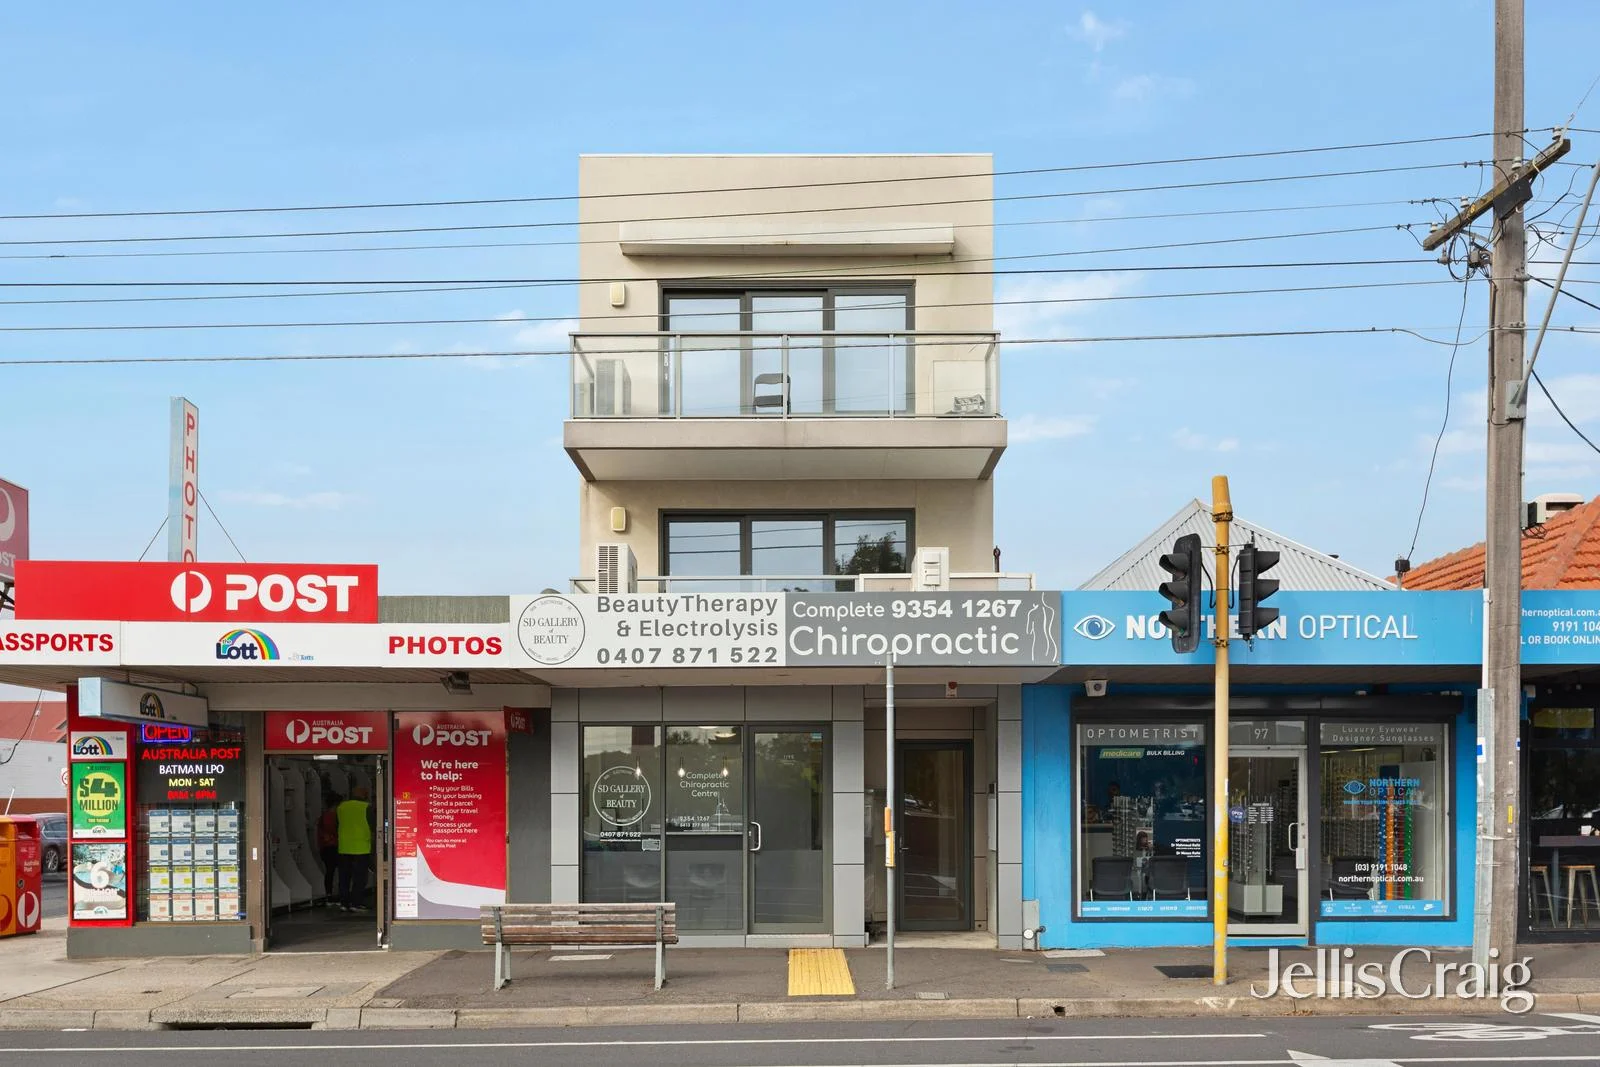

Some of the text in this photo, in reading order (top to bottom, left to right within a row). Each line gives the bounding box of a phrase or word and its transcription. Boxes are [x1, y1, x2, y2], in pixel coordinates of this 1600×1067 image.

[225, 573, 359, 613] POST
[792, 599, 1022, 621] Complete 9354 1267
[523, 617, 578, 627] SD GALLERY
[1299, 614, 1418, 639] OPTICAL
[1552, 621, 1578, 632] 9191
[616, 619, 778, 640] & Electrolysis
[0, 633, 113, 652] SSPORTS
[534, 634, 569, 644] BEAUTY
[789, 625, 1019, 663] Chiropractic
[1528, 635, 1541, 644] OR
[1544, 635, 1570, 644] BOOK
[216, 642, 258, 660] Lott
[388, 635, 502, 656] PHOTOS
[597, 647, 777, 664] 0407 871 522
[144, 725, 189, 739] OPEN
[312, 726, 373, 744] POST
[1087, 728, 1197, 738] OPTOMETRIST
[1254, 728, 1268, 739] 97
[1342, 725, 1419, 734] Luxury Eyewear
[436, 730, 492, 746] POST
[1332, 734, 1434, 743] Designer Sunglasses
[73, 744, 100, 755] Lott
[142, 748, 241, 760] AUSTRALIA POST
[159, 764, 224, 774] BATMAN LPO
[421, 760, 479, 769] We're here
[421, 770, 463, 782] to help:
[79, 778, 118, 797] $4
[168, 778, 192, 787] MON
[199, 778, 215, 786] SAT
[680, 780, 729, 789] Chiropractic
[1369, 778, 1420, 786] NORTHERN
[597, 784, 646, 793] SD GALLERY
[691, 789, 718, 797] Centre
[1369, 787, 1418, 796] OPTICA
[79, 799, 118, 811] MILLION
[606, 800, 637, 808] BEAUTY
[1355, 863, 1408, 871] (03) 9191 1048
[1338, 875, 1424, 883] northernoptical.com.au
